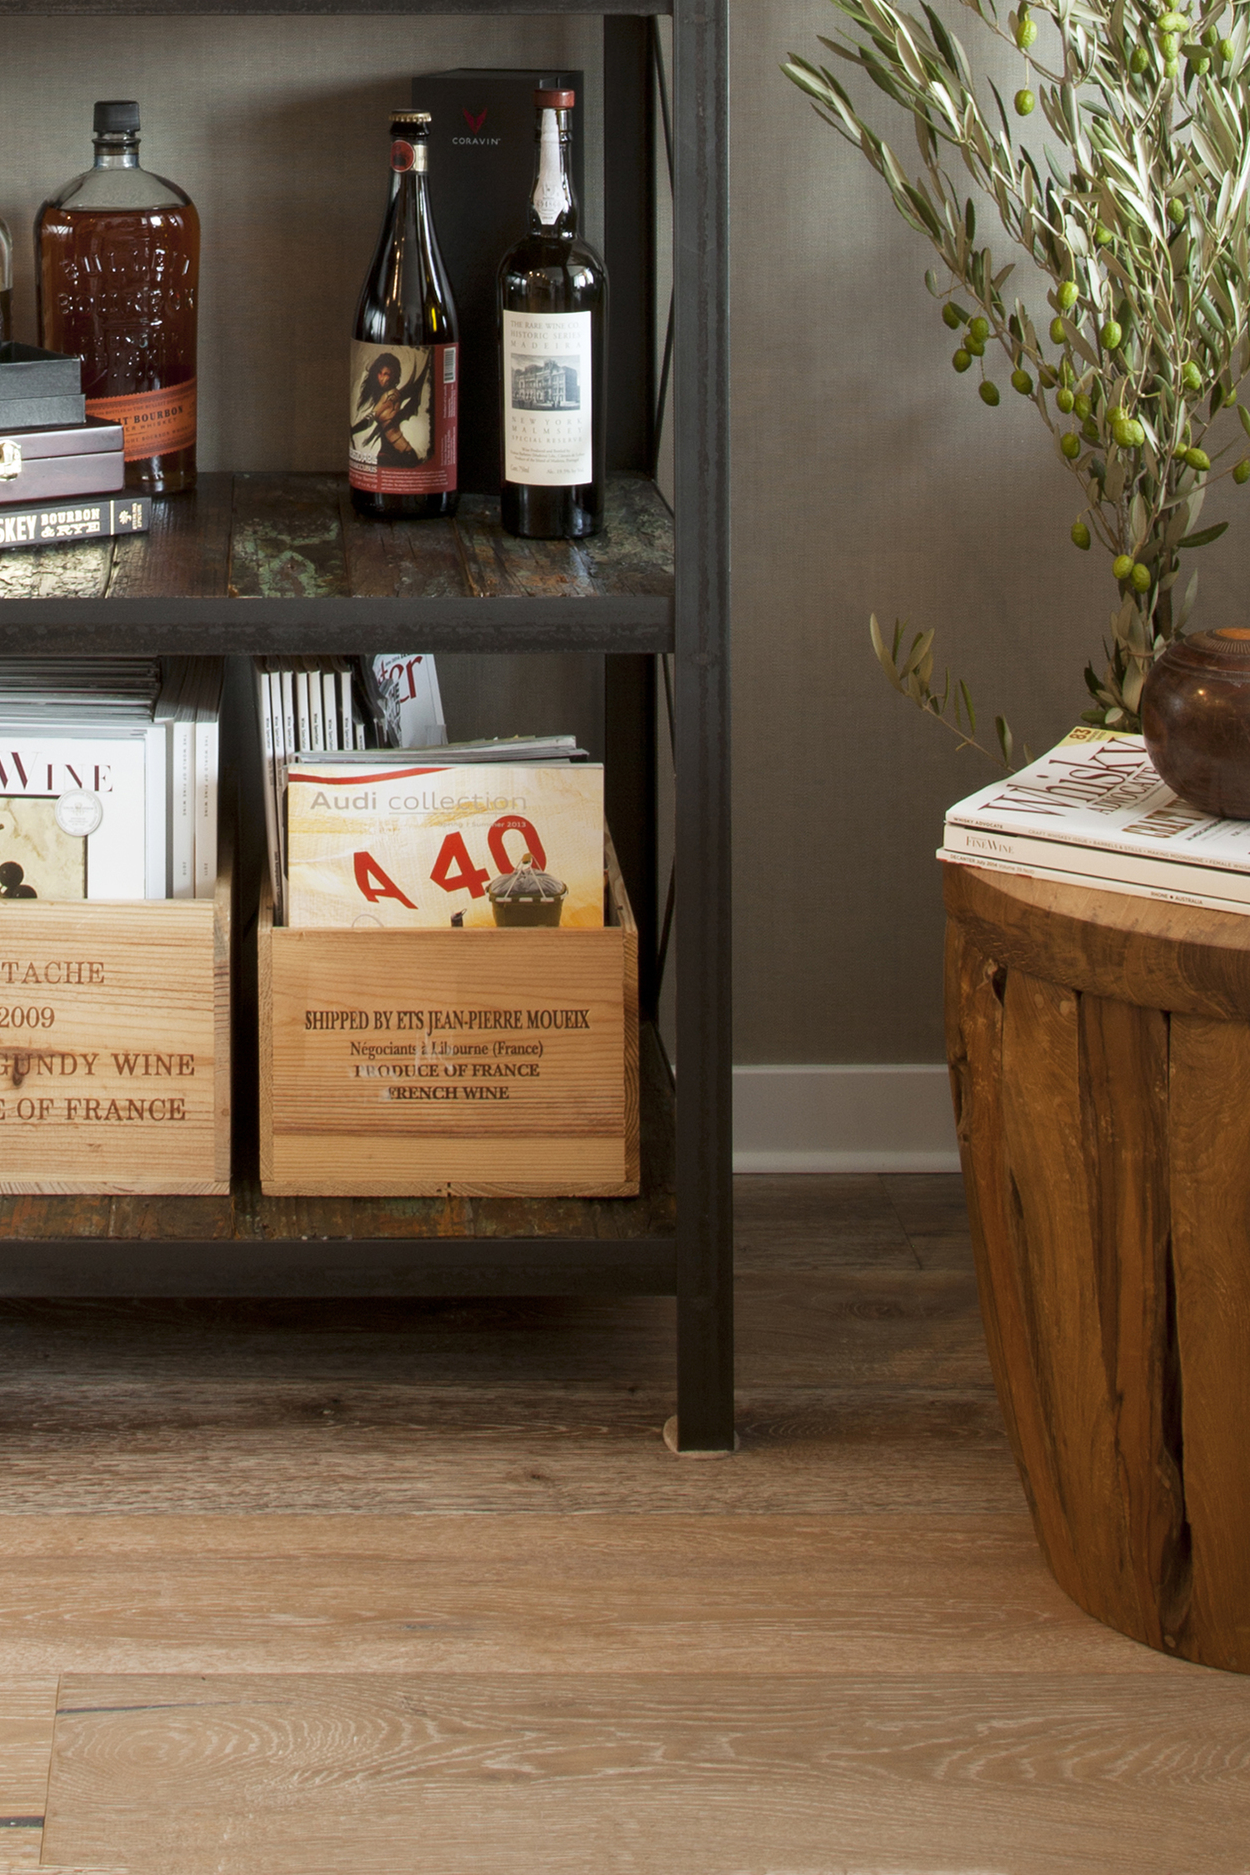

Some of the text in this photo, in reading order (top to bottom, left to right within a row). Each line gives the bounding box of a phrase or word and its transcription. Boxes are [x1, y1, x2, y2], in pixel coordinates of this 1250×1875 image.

[452, 137, 499, 145] CORAVIN
[510, 320, 565, 330] THE WINE
[510, 330, 582, 340] HISTORIC SERIES
[510, 339, 582, 350] MADEIRA
[133, 406, 184, 424] BOURBON
[511, 416, 583, 426] NEW YORK
[511, 425, 584, 435] MALMSEY
[40, 507, 101, 526] BOURBON
[1068, 727, 1093, 741] 83
[976, 735, 1148, 817] Whisky
[309, 791, 529, 815] Audi collection
[507, 821, 527, 829] 2013
[953, 816, 975, 825] WHISKY
[974, 819, 1004, 830] ADVOCATE
[1027, 828, 1047, 838] CRAFT
[1092, 840, 1119, 851] BARRELS
[1124, 845, 1142, 855] STILLS
[1147, 848, 1170, 859] MAKING
[1170, 852, 1204, 864] MOONSHINE
[1209, 859, 1232, 869] FEMALE
[353, 851, 419, 910] A
[1174, 895, 1204, 906] AUSTRALIA
[0, 961, 105, 986] TACHE
[304, 1009, 591, 1036] SHIPPED BY ETS JEAN-PIERRE MOUEIX
[350, 1040, 545, 1059] Négociants (France)
[114, 1052, 196, 1077] WINE
[354, 1063, 541, 1078] PRODUCE OF FRANCE
[388, 1085, 510, 1101] FRENCH WINE
[16, 1097, 54, 1122] OF
[64, 1097, 187, 1122] FRANCE
